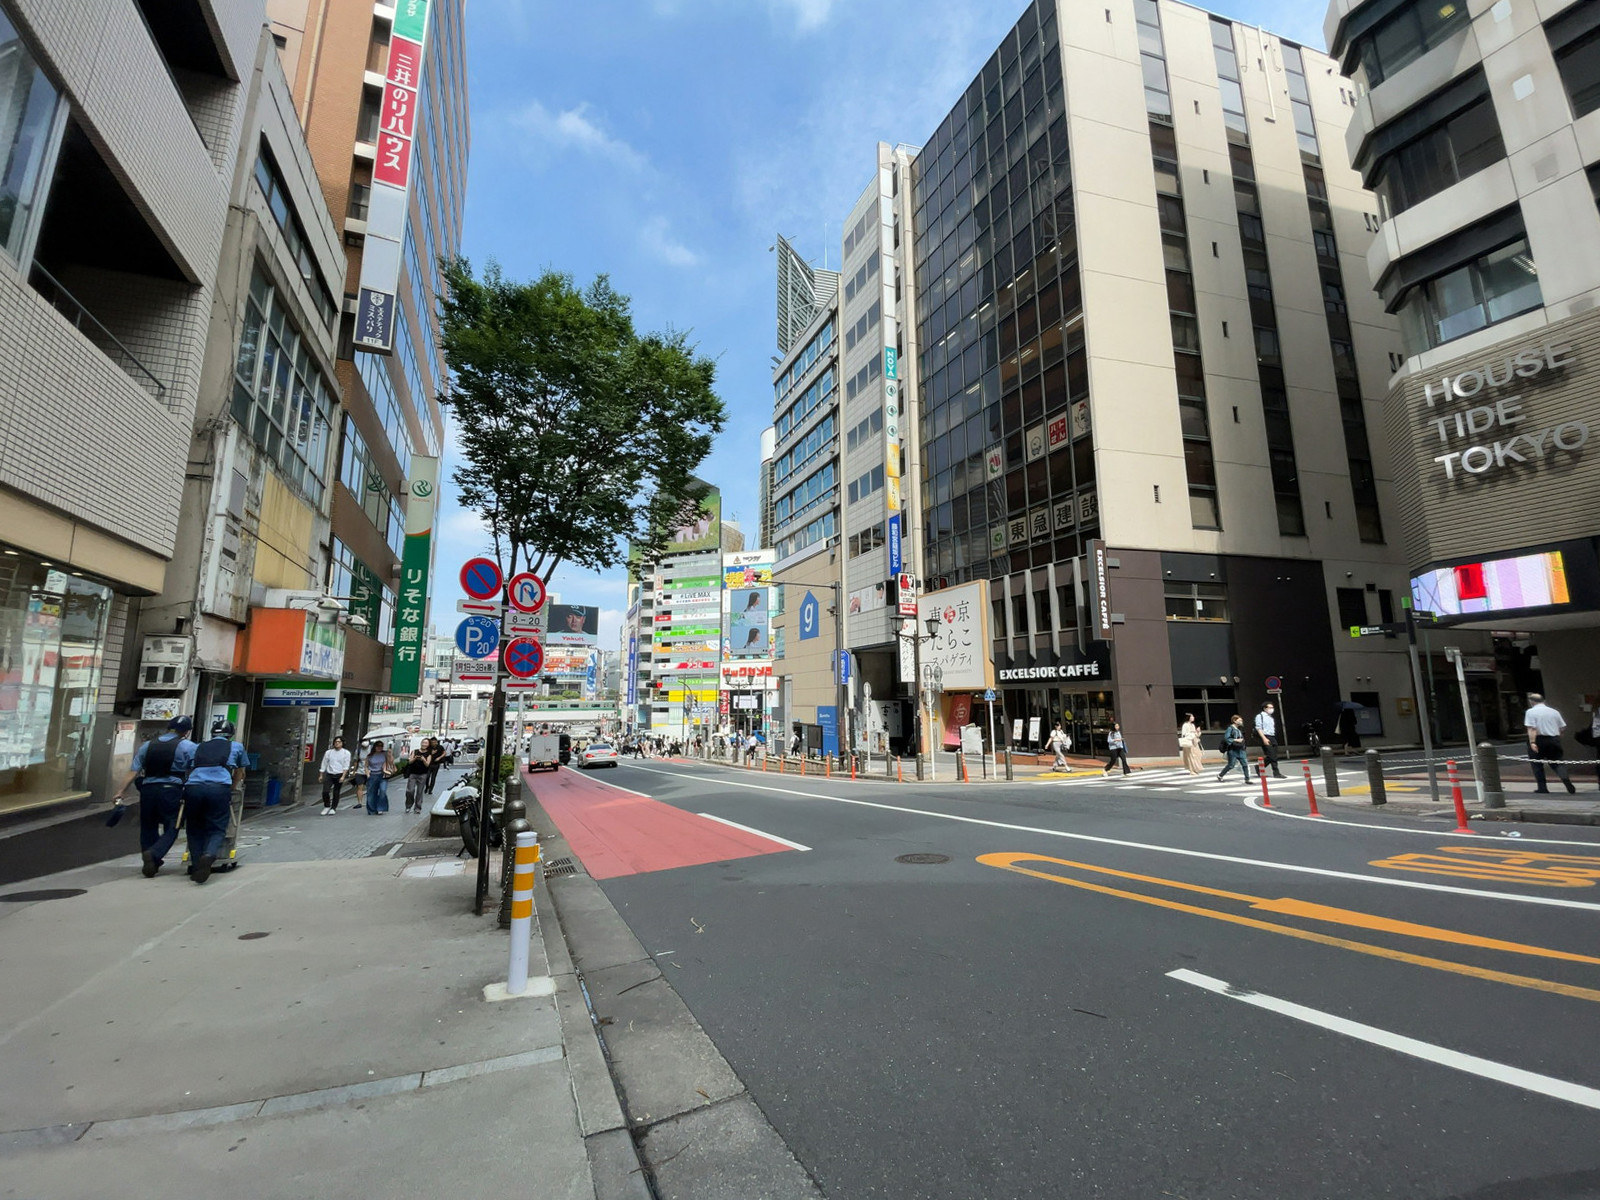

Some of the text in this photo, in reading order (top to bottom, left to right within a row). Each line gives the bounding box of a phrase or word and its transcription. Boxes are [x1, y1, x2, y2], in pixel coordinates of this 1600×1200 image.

[383, 53, 413, 171] 三井のリハウス
[887, 351, 895, 377] NOVA
[1424, 339, 1577, 407] HOUSE
[1427, 394, 1527, 442] TIDE
[1434, 420, 1590, 479] TOKYO
[1010, 495, 1099, 541] 東急建設
[1097, 549, 1107, 598] EXCELSIOR
[398, 568, 422, 661] りそな銀行
[468, 618, 492, 627] 9-20
[804, 603, 814, 632] g
[465, 626, 483, 653] P
[476, 641, 490, 654] 20
[931, 629, 972, 651] たらこ
[932, 653, 972, 667] スパゲティ
[999, 660, 1100, 680] EXCELSIOR CAFFÉ
